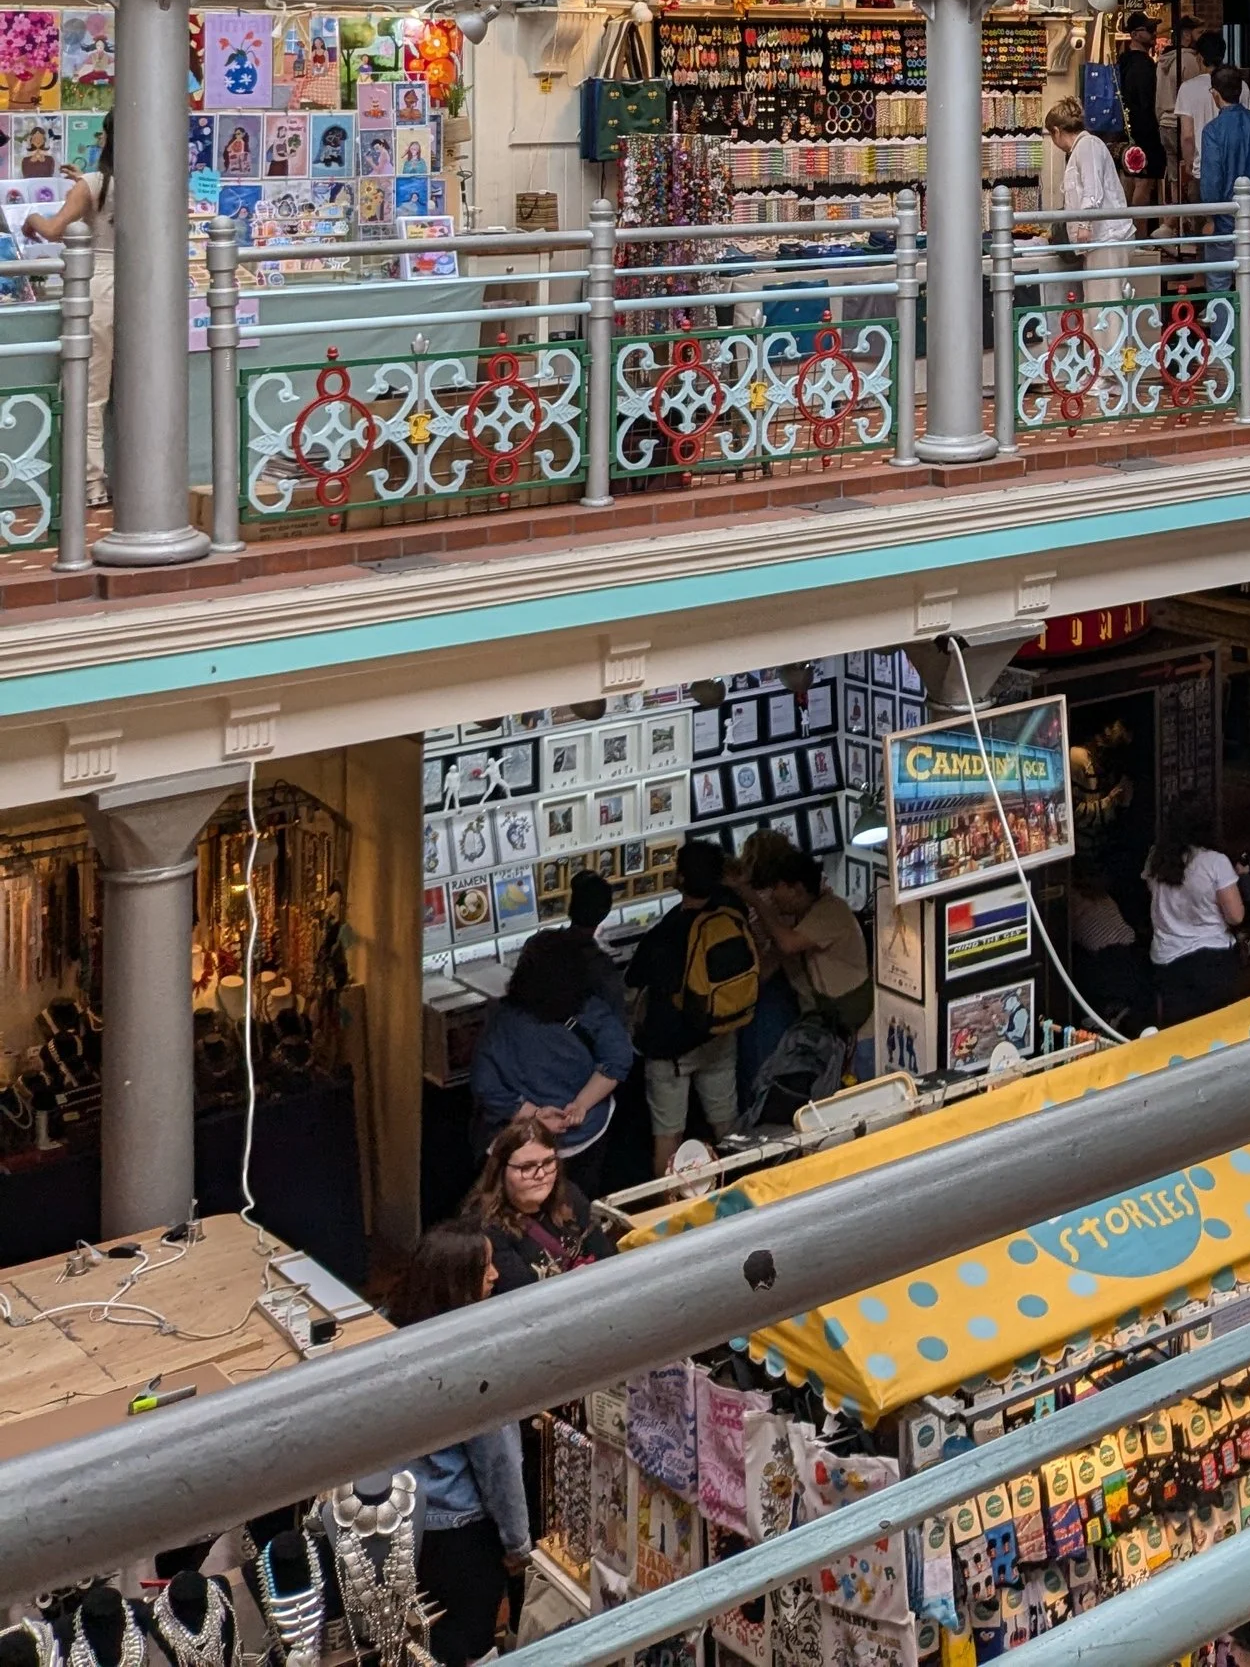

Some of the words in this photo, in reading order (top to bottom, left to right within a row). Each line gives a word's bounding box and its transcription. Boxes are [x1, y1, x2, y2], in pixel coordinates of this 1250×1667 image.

[906, 746, 1012, 779] CAMDEN
[451, 875, 487, 890] RAMEN
[953, 941, 979, 953] MIND
[982, 935, 1000, 945] THE
[1058, 1182, 1196, 1263] STORIES
